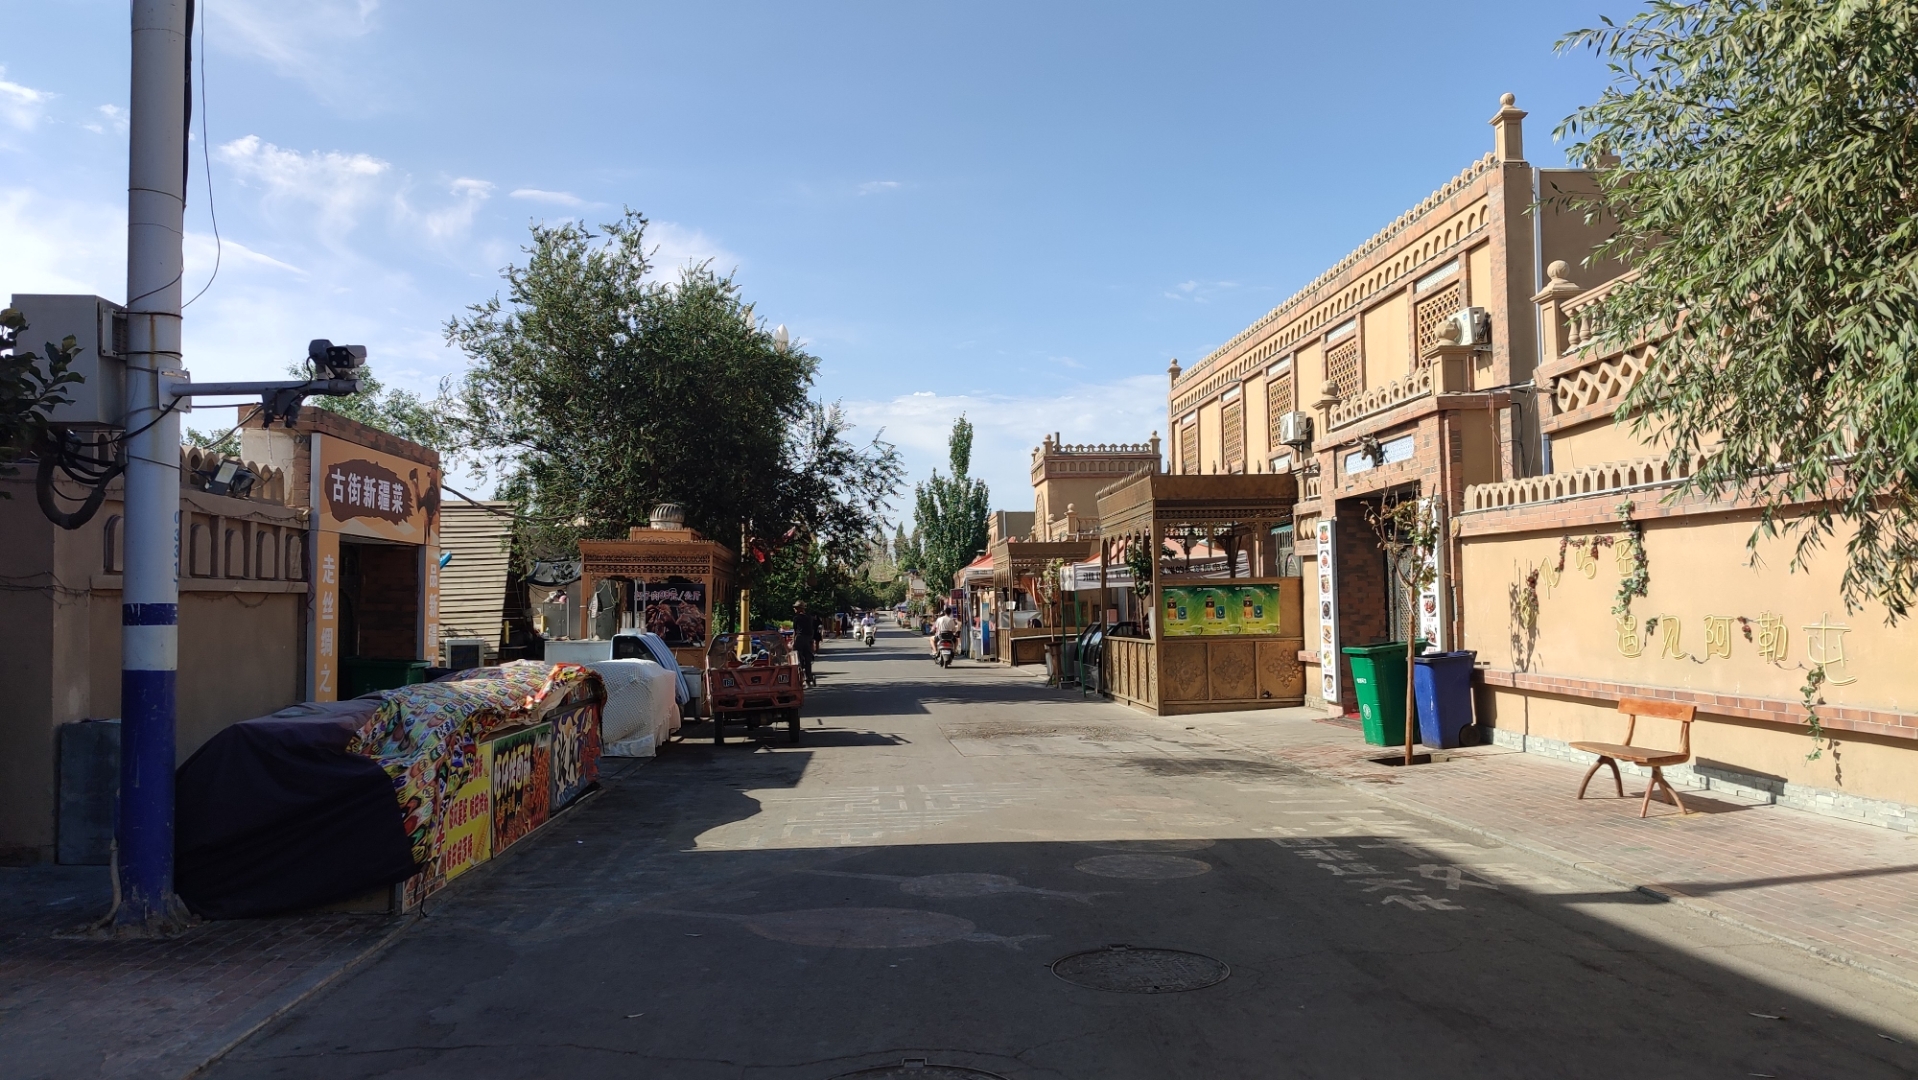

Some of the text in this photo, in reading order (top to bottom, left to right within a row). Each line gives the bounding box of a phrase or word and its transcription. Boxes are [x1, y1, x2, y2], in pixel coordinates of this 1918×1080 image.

[331, 468, 404, 514] 古街新疆菜
[319, 553, 336, 702] 走丝绸之
[1614, 610, 1857, 686] 遇见阿勒屯
